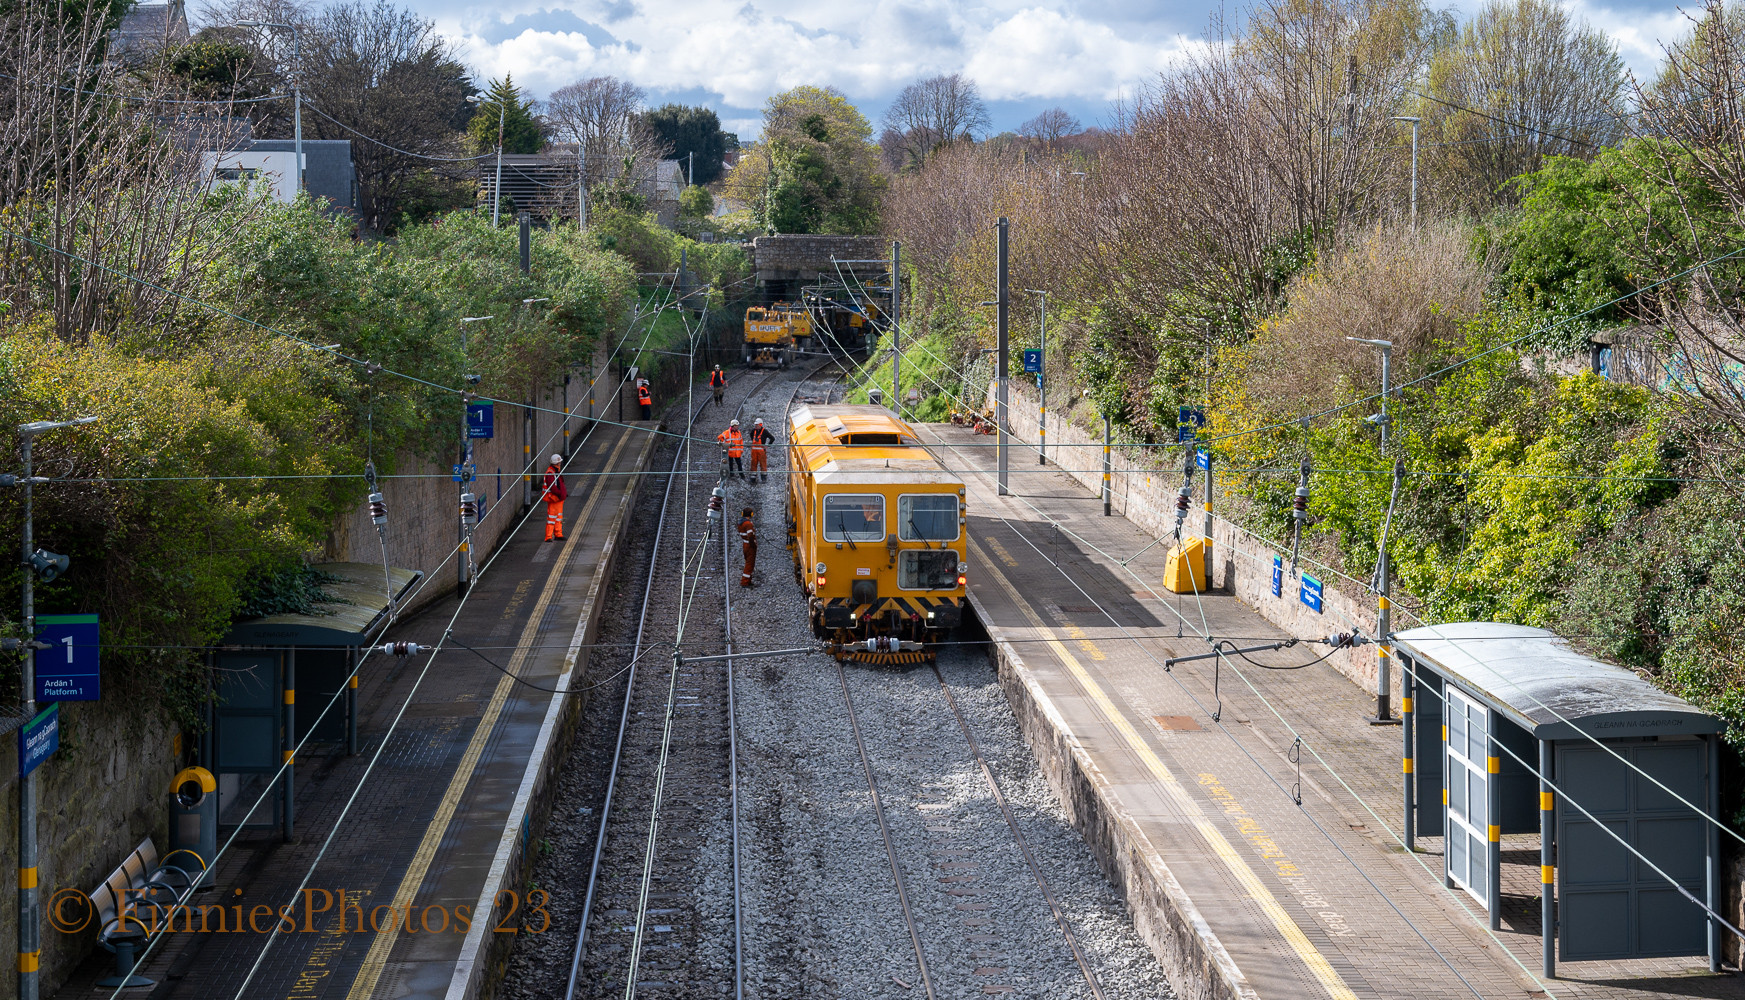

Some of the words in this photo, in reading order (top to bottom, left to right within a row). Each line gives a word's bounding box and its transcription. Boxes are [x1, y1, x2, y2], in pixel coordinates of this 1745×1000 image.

[1030, 354, 1036, 362] 2
[478, 409, 483, 422] 1
[61, 636, 73, 664] 1
[44, 687, 78, 696] Platform
[1318, 910, 1356, 936] Keep
